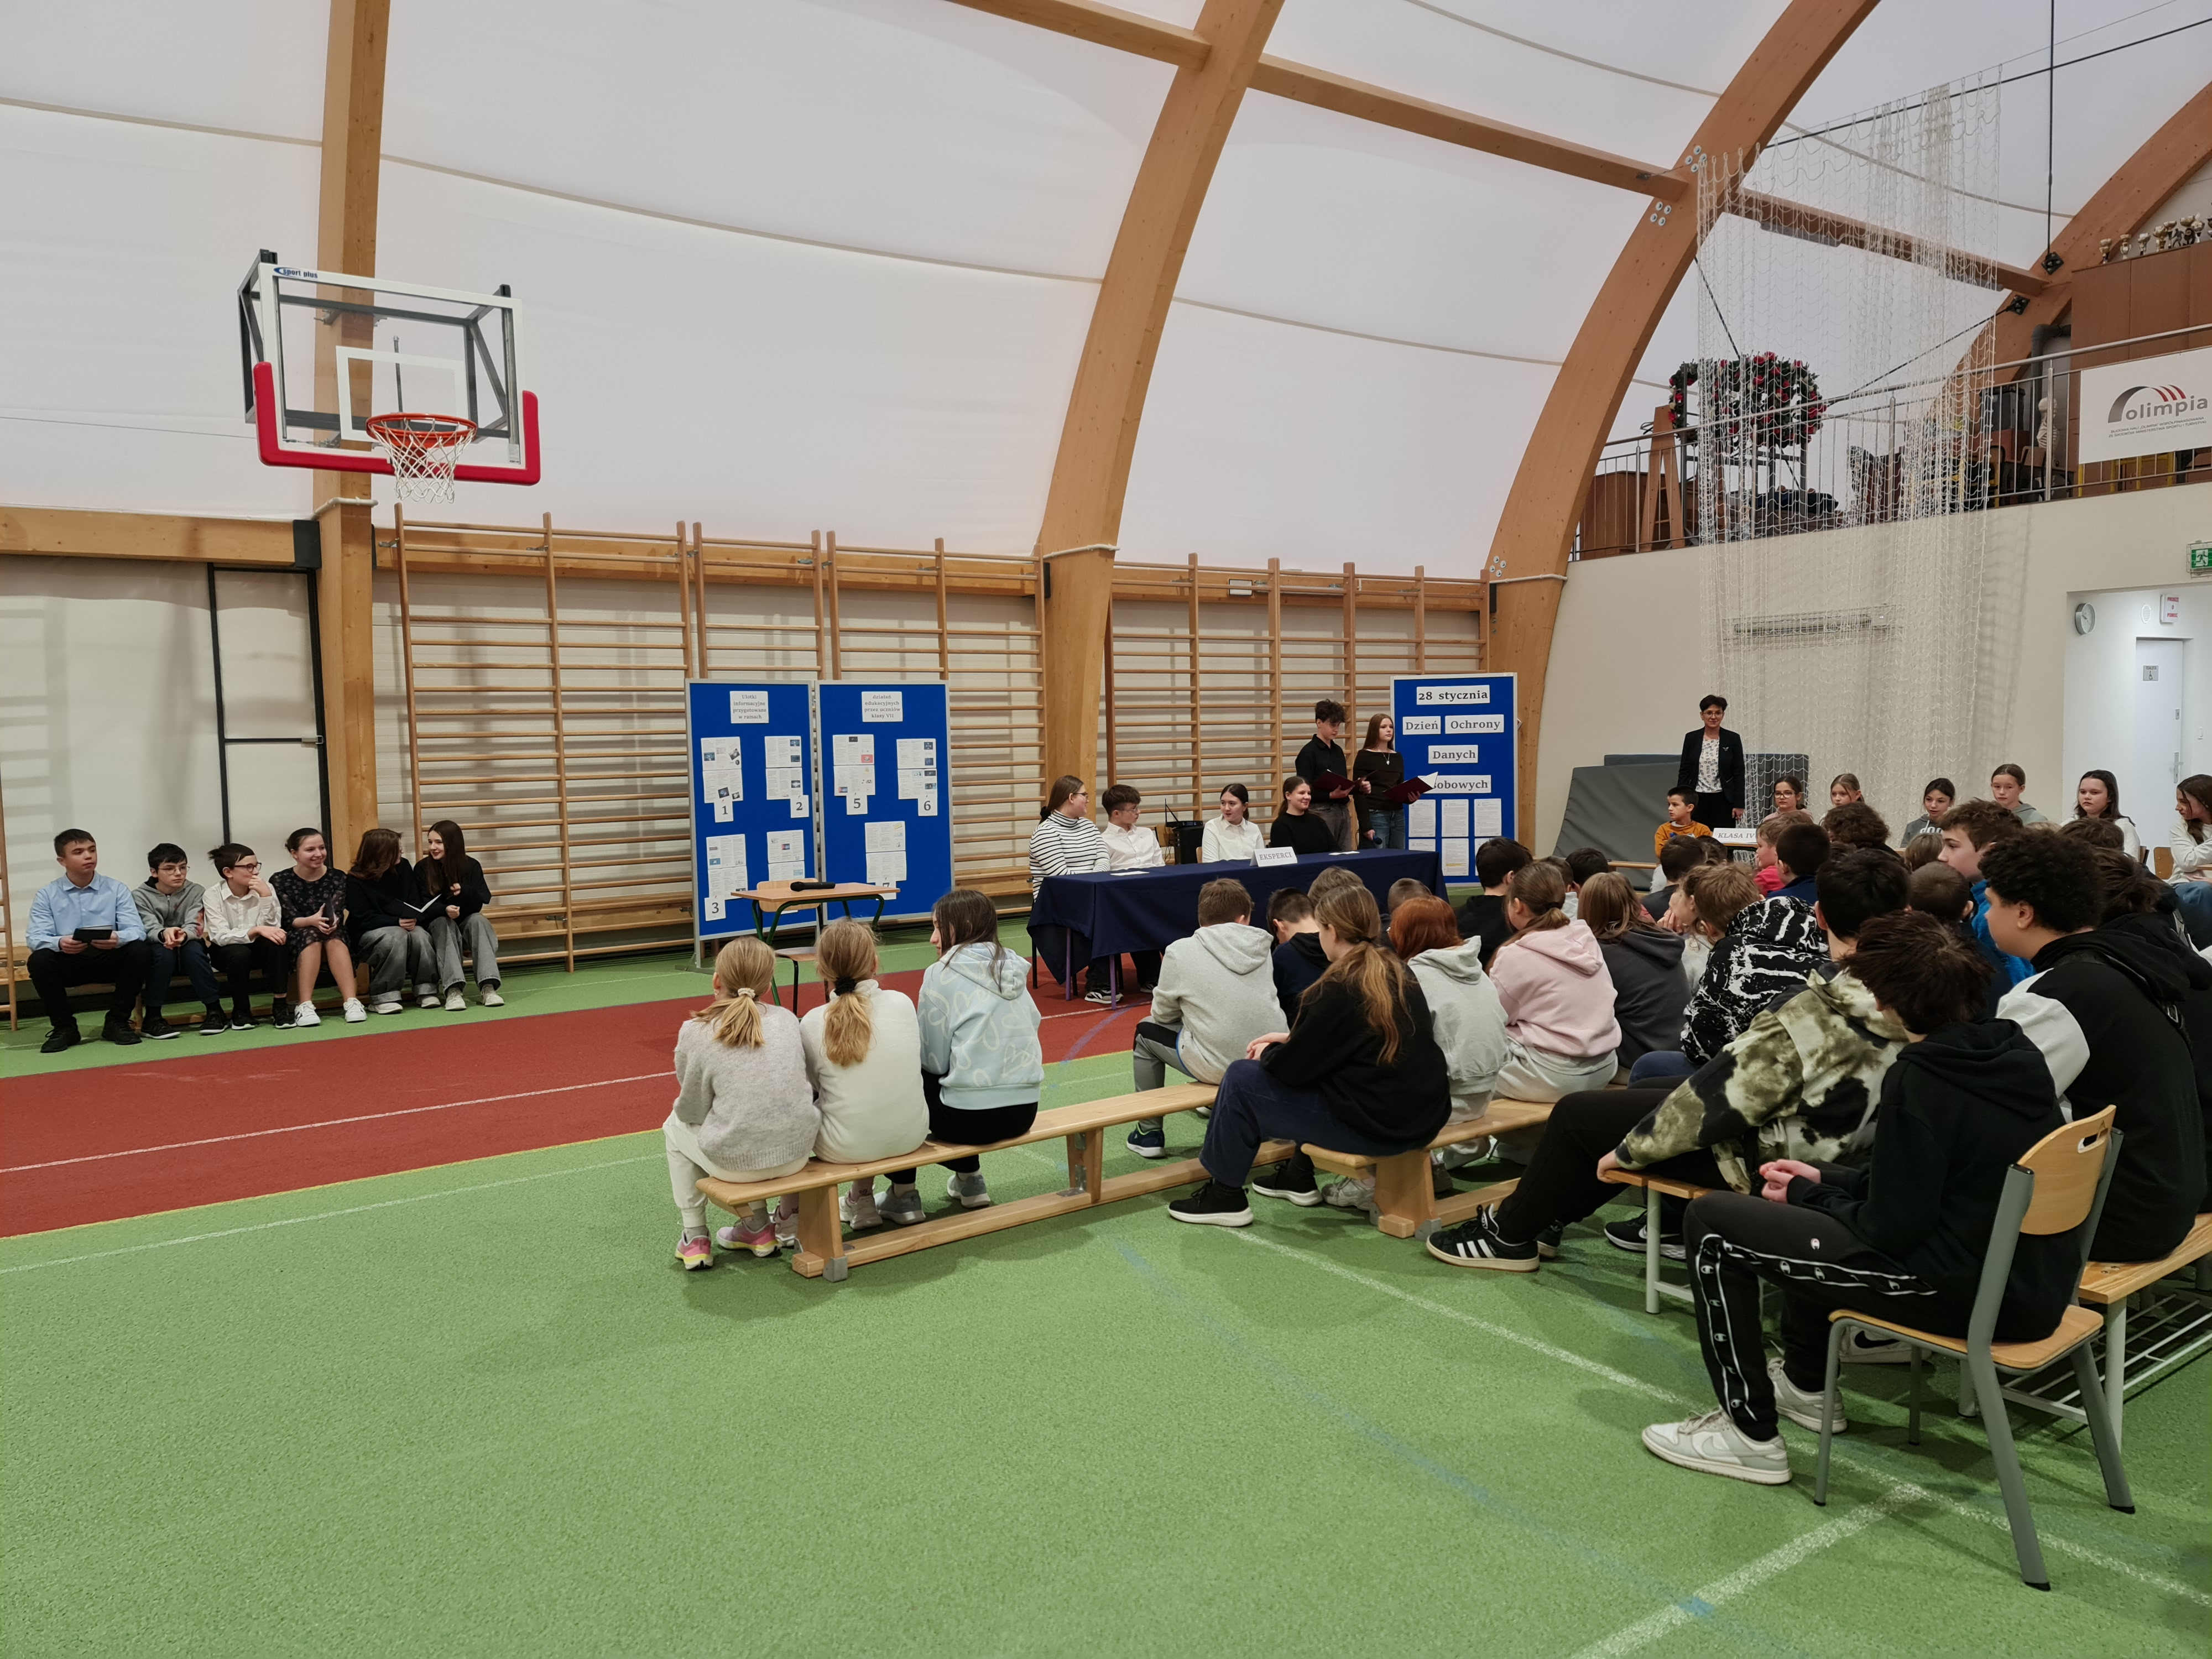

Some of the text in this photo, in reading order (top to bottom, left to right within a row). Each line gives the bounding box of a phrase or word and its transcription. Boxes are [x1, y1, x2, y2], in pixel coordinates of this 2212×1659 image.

[2126, 395, 2208, 420] olimpia
[1418, 690, 1488, 702] 28 stycznia
[1405, 720, 1501, 730] Dzień Ochrony
[1432, 750, 1476, 761] Danych
[796, 802, 803, 811] 2
[853, 798, 861, 808] 5
[924, 801, 931, 811] 6
[722, 806, 728, 815] 1
[1259, 852, 1292, 860] EKSPERCI
[711, 902, 719, 913] 3
